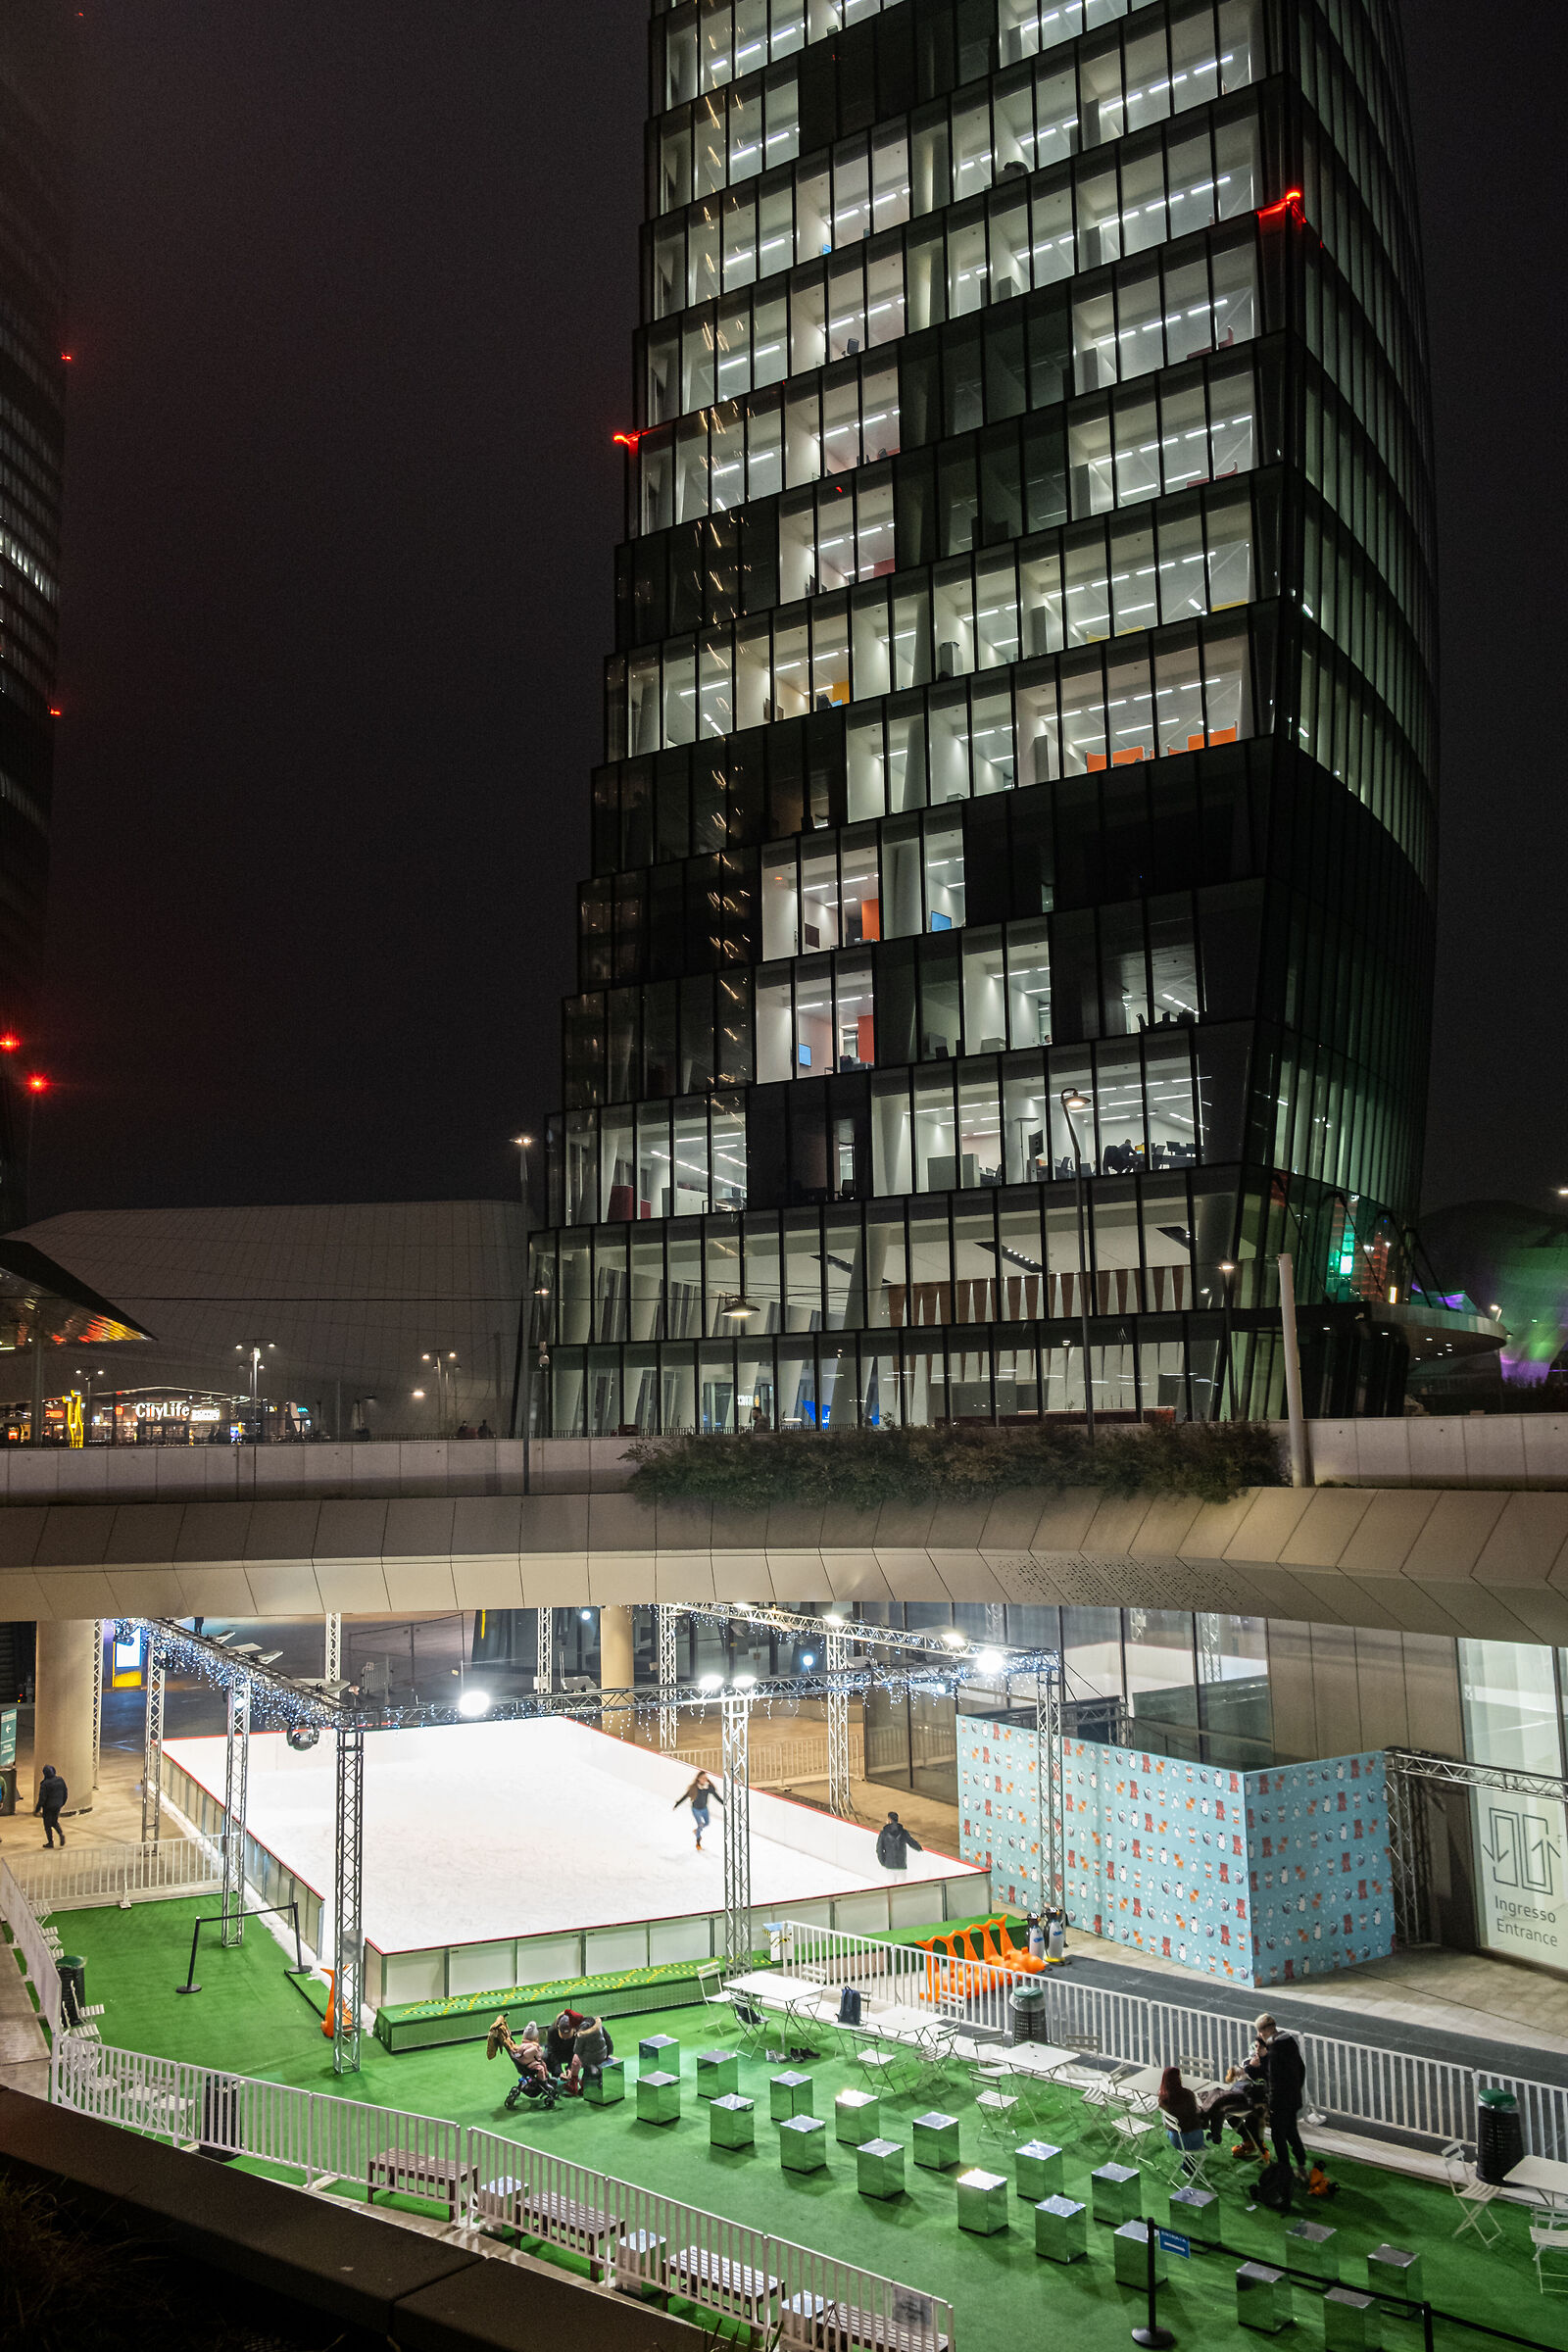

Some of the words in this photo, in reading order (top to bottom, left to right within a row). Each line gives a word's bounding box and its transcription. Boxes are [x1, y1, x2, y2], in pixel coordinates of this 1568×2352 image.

[135, 1402, 190, 1421] CityLife
[1495, 1895, 1556, 1924] Ingresso
[1496, 1918, 1558, 1947] Entrance
